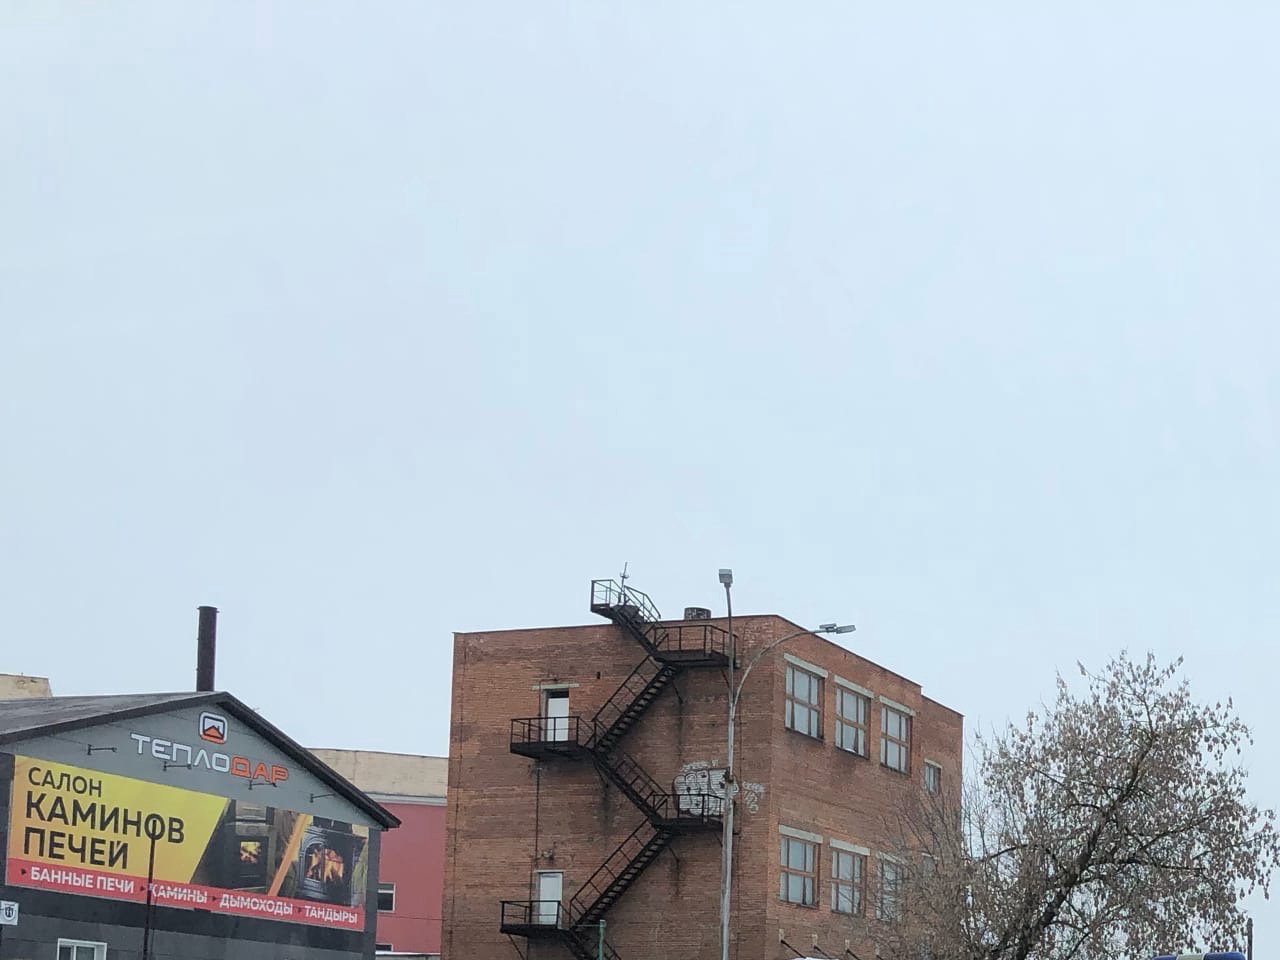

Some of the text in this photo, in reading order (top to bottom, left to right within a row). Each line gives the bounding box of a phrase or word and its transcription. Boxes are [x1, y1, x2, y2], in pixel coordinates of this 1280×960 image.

[28, 767, 102, 797] САЛОН
[130, 733, 289, 783] ТЕПЛОДАР
[26, 791, 184, 843] КАМИНОВ
[24, 827, 128, 869] ПЕЧЕЙ
[31, 866, 357, 924] БАННЫЕ ПЕЧИ КАМИНЫ ДЫМОХОДЫ ТАНДЫРЫ
